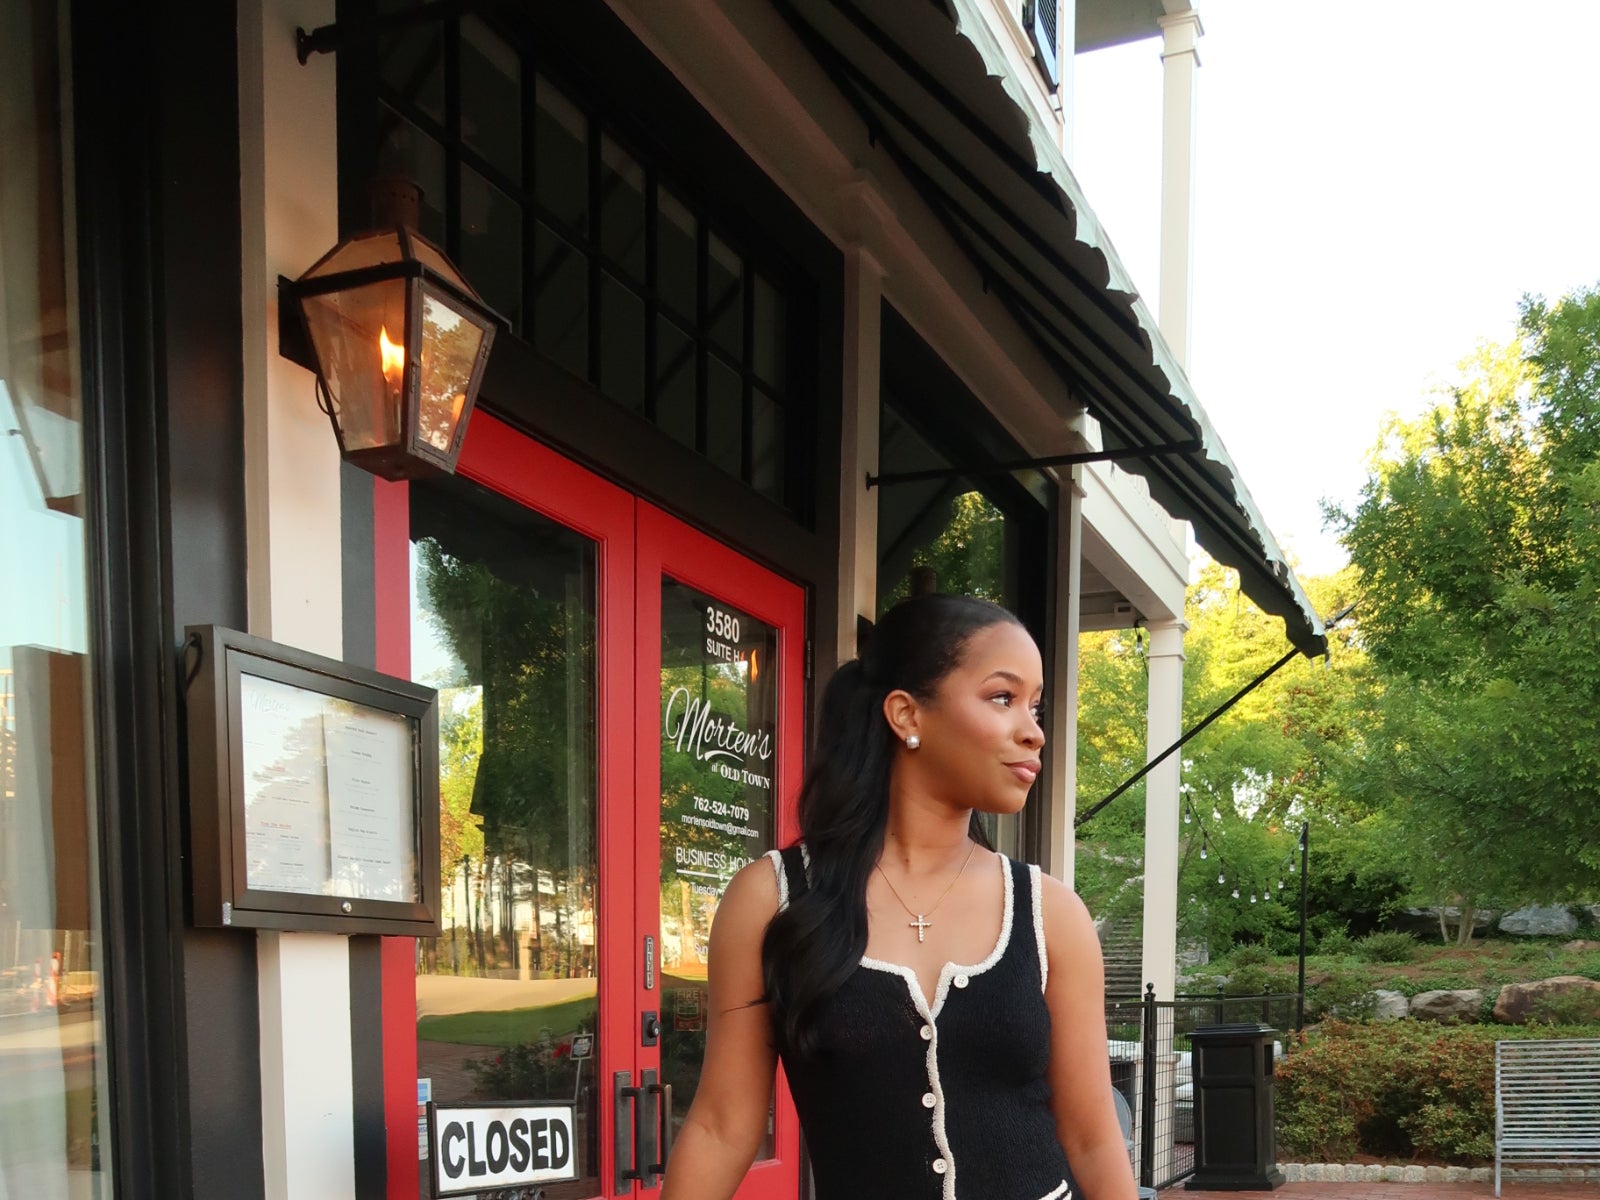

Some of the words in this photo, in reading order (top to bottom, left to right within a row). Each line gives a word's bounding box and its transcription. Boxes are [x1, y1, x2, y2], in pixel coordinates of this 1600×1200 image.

[706, 606, 740, 643] 3580
[706, 638, 732, 661] SUITE
[733, 649, 740, 664] H
[665, 687, 772, 760] Morten's
[720, 764, 740, 781] OLD
[741, 769, 771, 789] TOWN
[693, 796, 750, 821] 762-524-7079
[675, 847, 727, 870] BUSINESS
[690, 881, 718, 897] Tuesday
[441, 1118, 570, 1179] CLOSED
